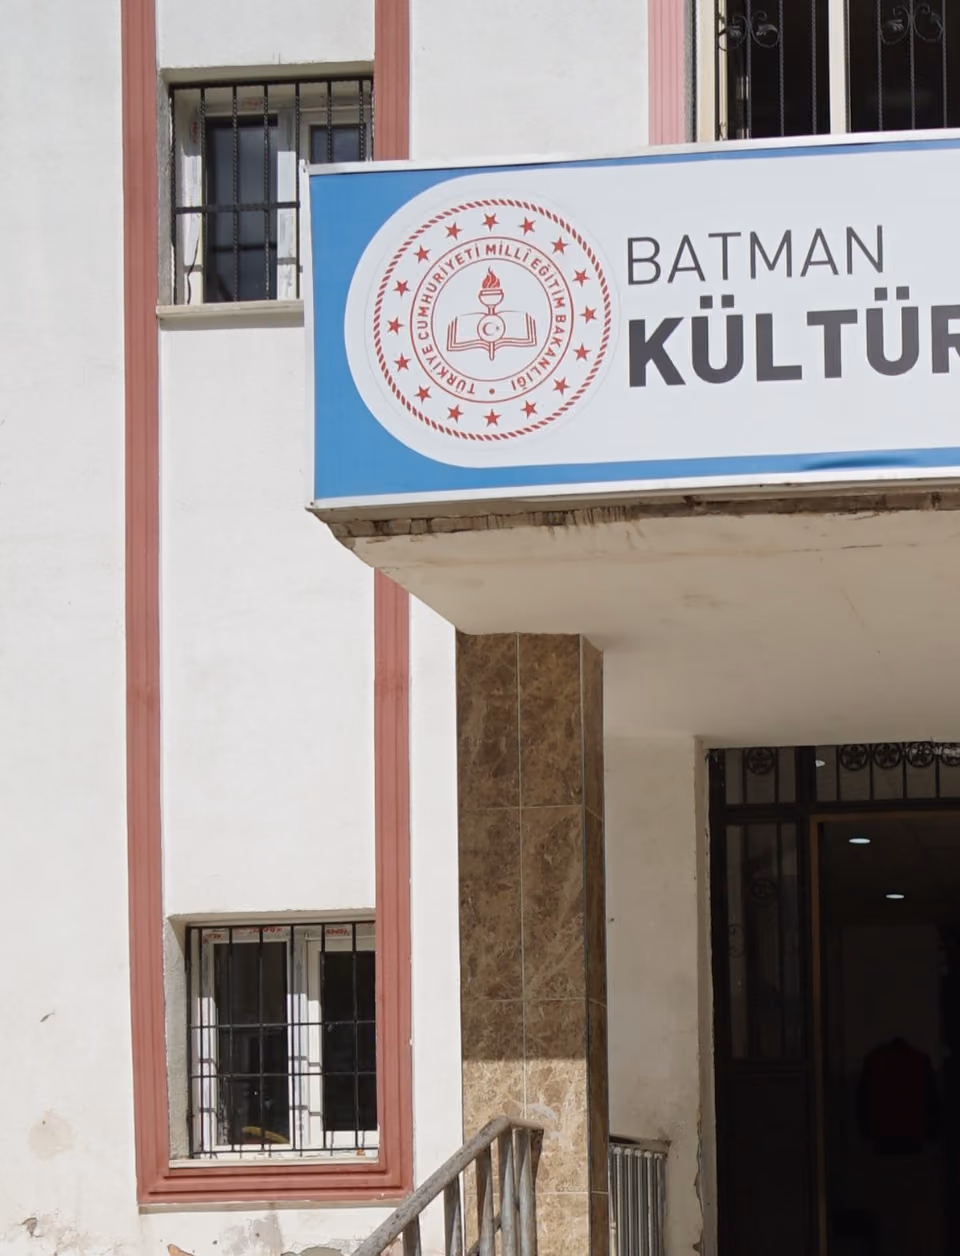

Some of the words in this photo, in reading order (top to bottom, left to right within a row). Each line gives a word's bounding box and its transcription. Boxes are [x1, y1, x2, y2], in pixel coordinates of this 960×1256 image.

[532, 257, 567, 309] EĞİTİM
[627, 225, 884, 286] BATMAN
[416, 243, 481, 341] CUMHURİYETİ
[421, 345, 476, 395] TÜRKİYE
[510, 313, 568, 392] BAKANLIĞI
